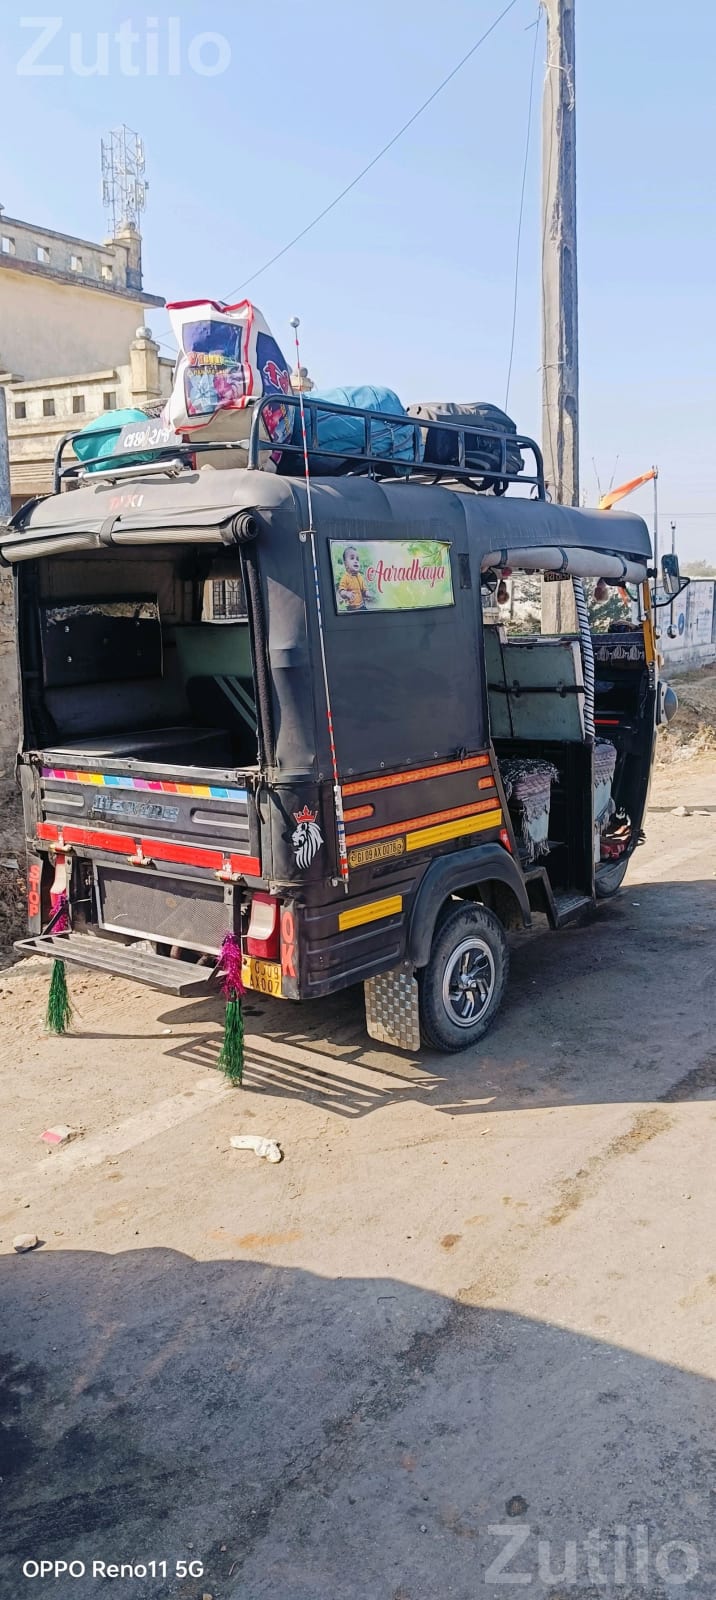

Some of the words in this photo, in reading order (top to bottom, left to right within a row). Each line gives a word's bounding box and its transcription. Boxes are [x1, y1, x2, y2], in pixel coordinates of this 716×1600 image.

[366, 558, 445, 594] Aaradhaya
[28, 864, 40, 918] STOP
[281, 910, 296, 977] OK
